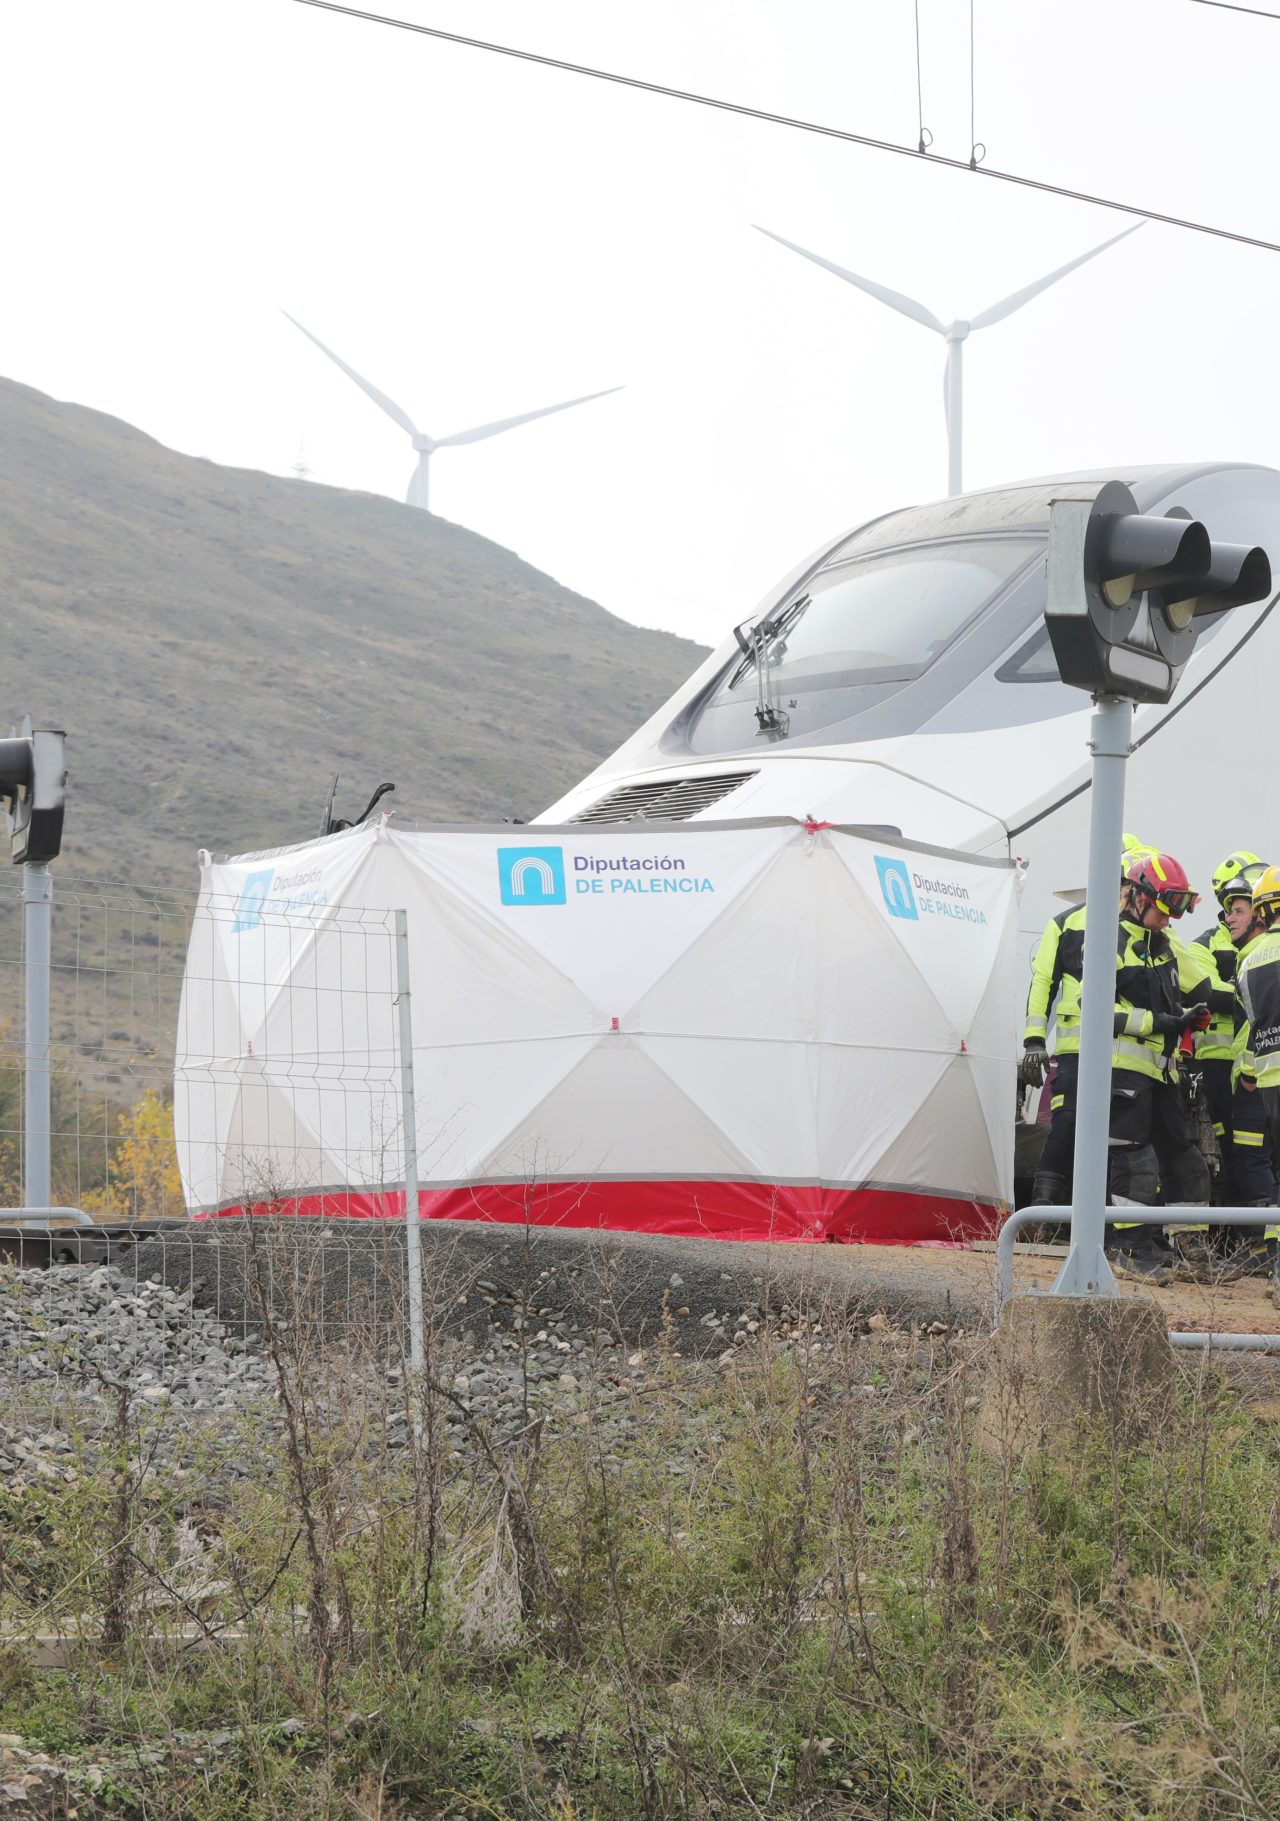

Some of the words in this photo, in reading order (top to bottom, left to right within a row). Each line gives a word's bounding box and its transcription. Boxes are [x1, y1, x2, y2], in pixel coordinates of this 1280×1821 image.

[574, 855, 685, 874] Diputación
[272, 867, 322, 892] Diputación
[576, 879, 604, 893] DE
[611, 878, 715, 893] PALENCIA
[913, 873, 970, 900] Diputación
[919, 897, 935, 914] DE
[936, 901, 988, 926] PALENCIA
